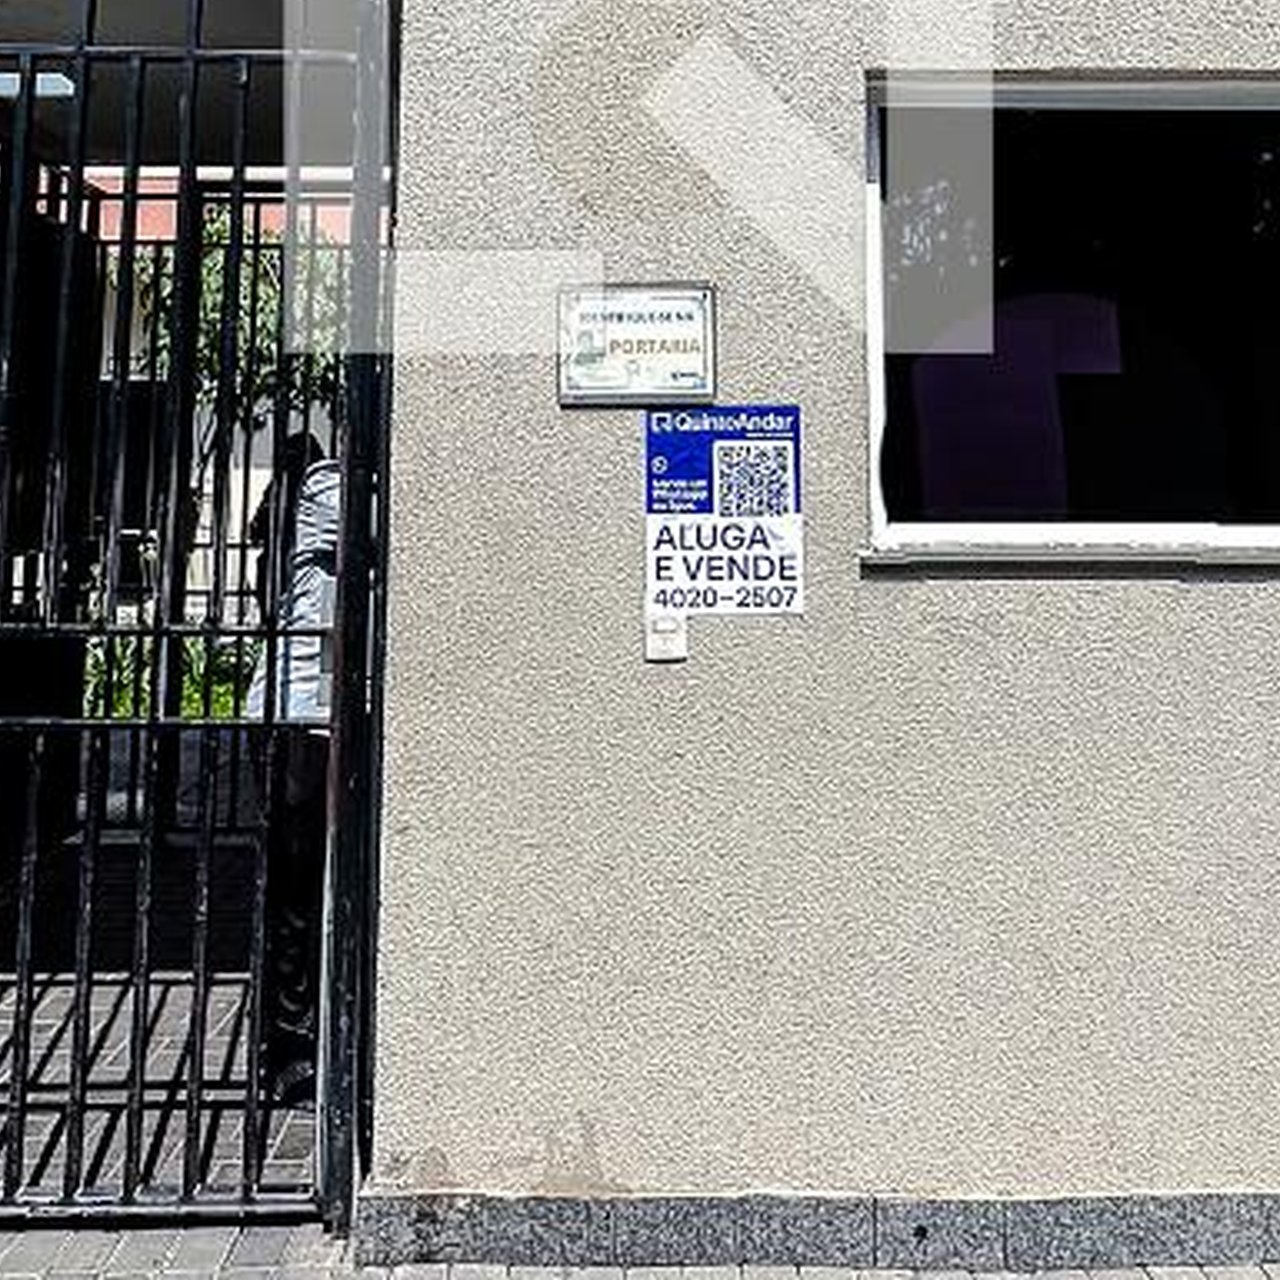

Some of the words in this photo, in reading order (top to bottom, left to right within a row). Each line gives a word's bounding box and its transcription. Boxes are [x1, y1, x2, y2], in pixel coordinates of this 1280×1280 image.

[608, 338, 701, 355] PORTARIA
[653, 523, 771, 551] ALUGA
[655, 555, 674, 581] E
[682, 555, 797, 581] VENDE
[653, 586, 798, 608] 4020-2507
